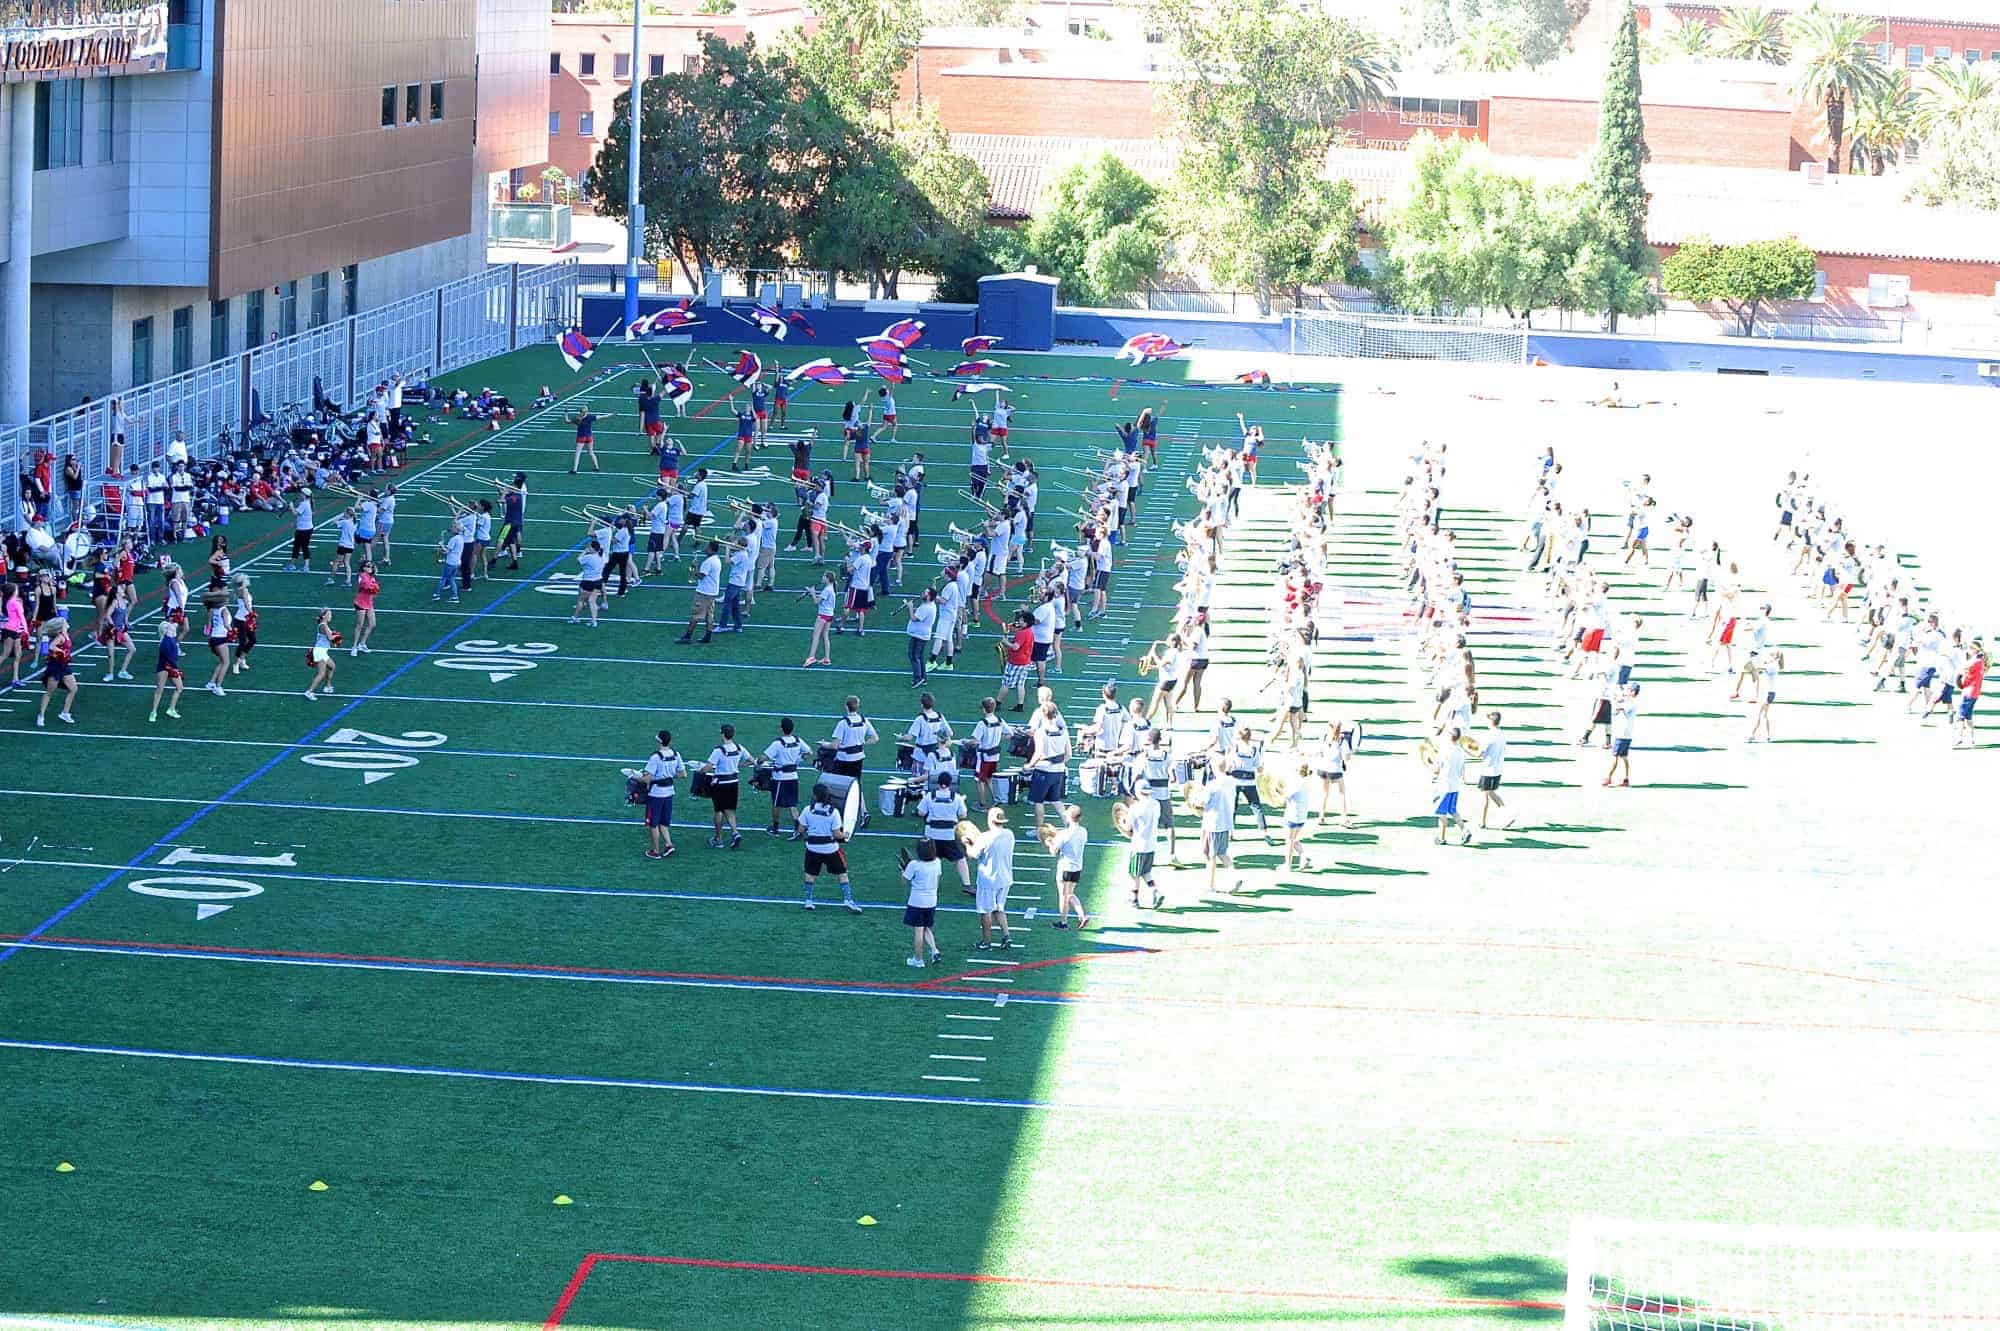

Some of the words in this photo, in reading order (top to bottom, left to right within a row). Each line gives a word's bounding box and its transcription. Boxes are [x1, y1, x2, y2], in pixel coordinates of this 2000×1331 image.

[5, 39, 74, 71] FOOTBALL
[433, 640, 559, 671] 30
[301, 728, 448, 769] 20
[127, 847, 298, 900] 10
